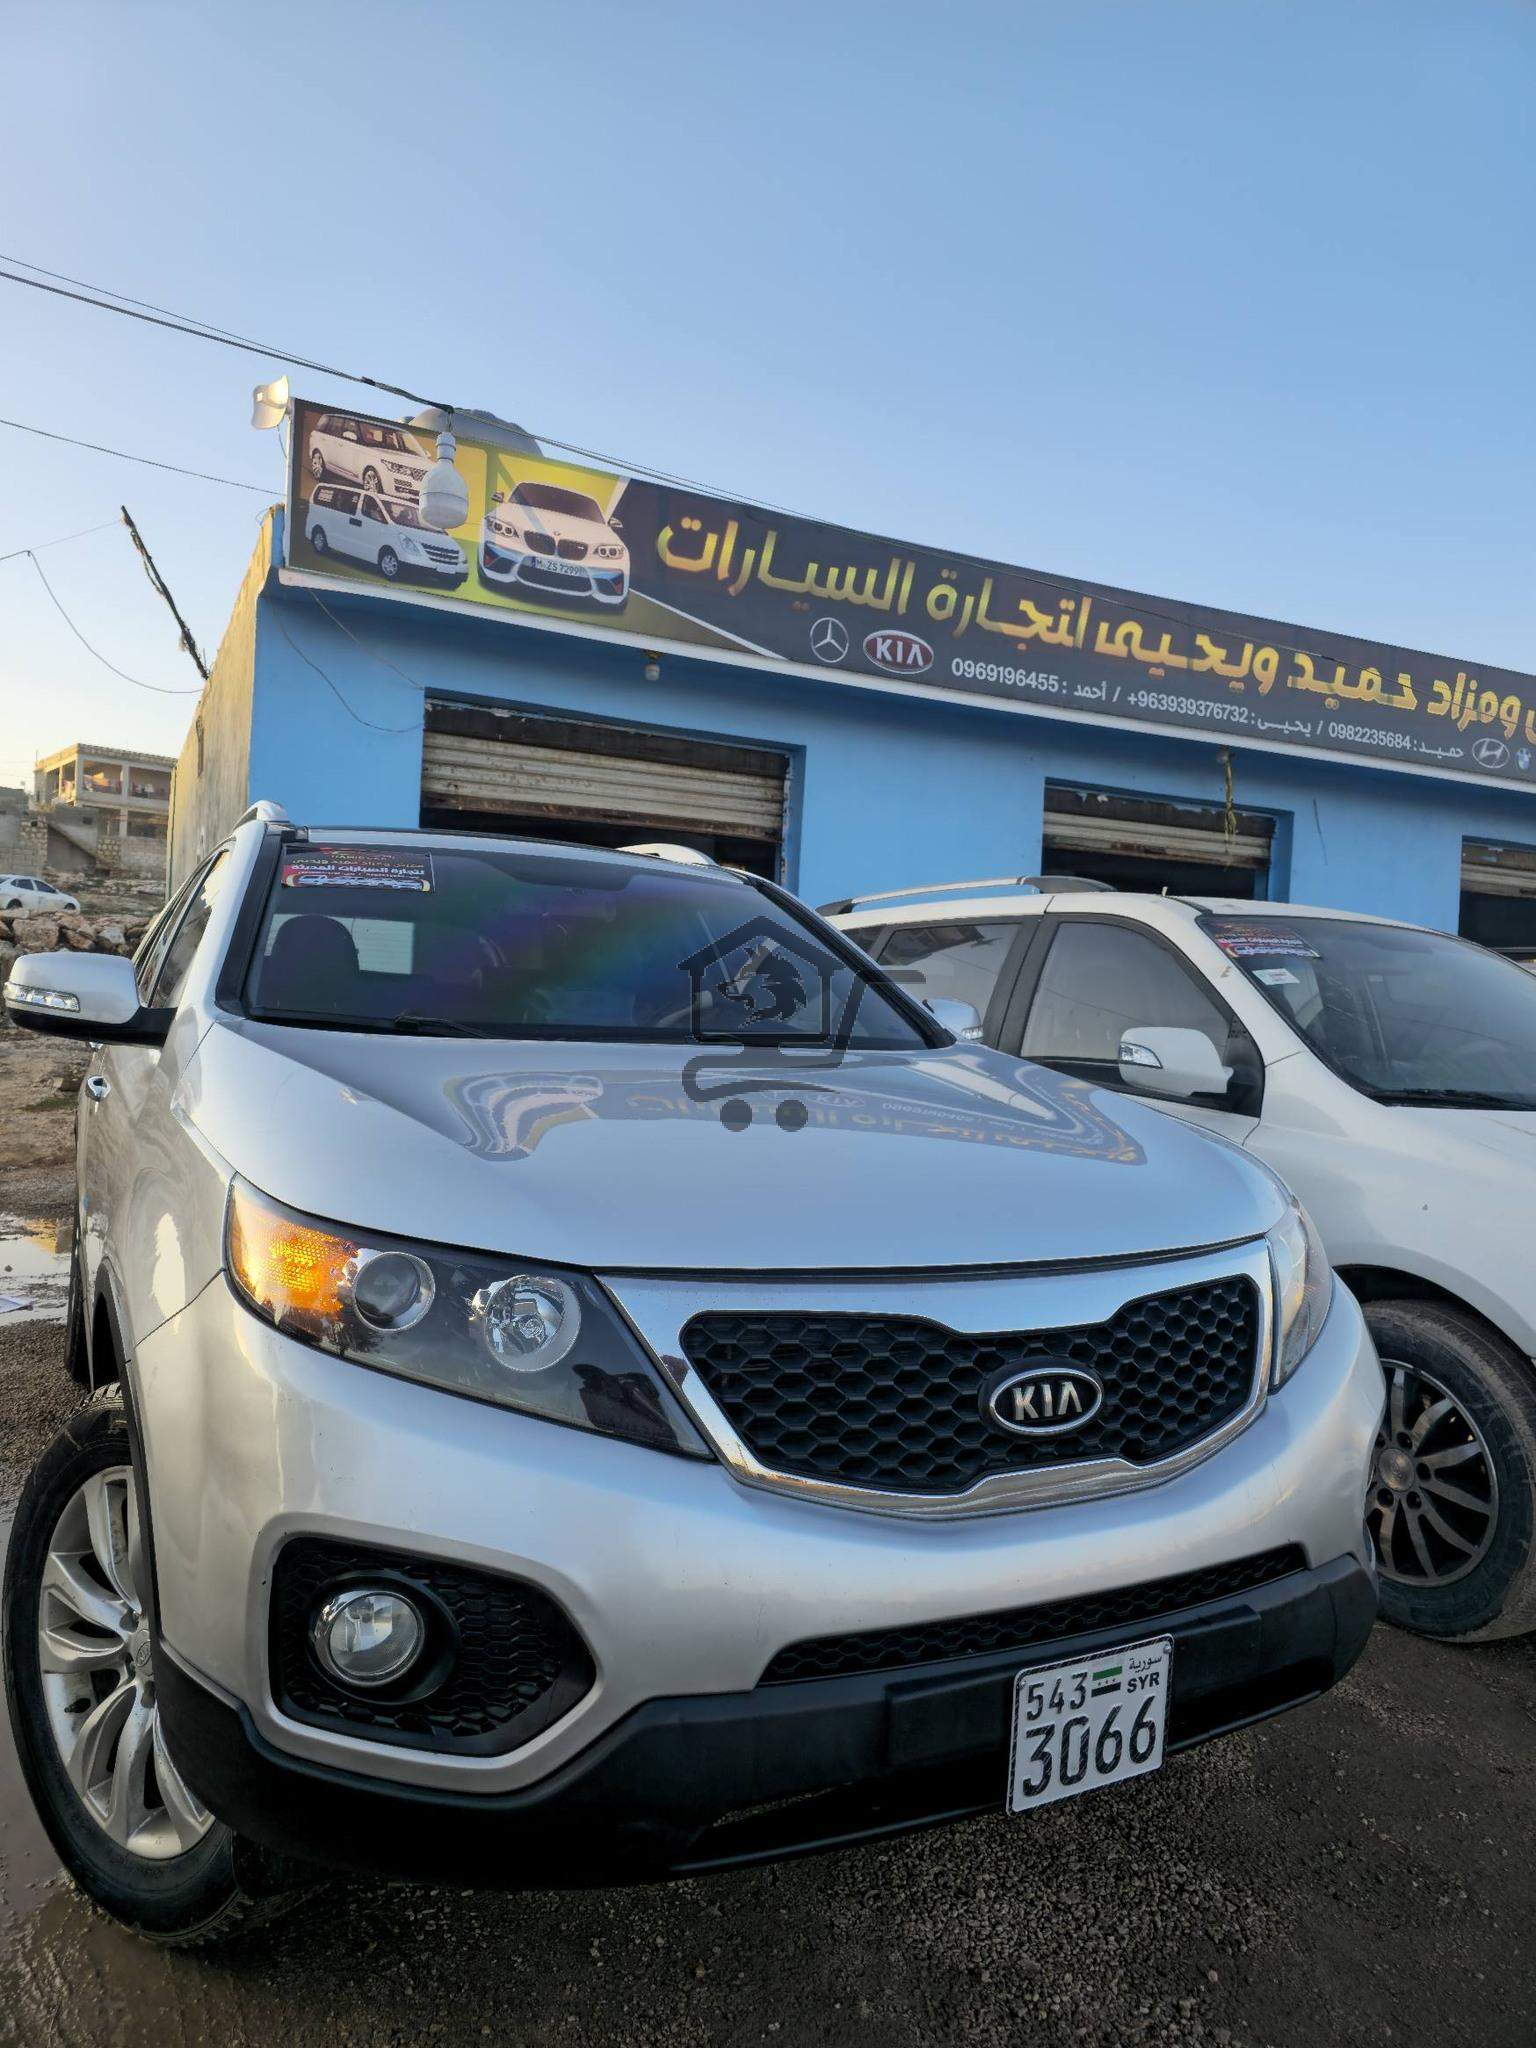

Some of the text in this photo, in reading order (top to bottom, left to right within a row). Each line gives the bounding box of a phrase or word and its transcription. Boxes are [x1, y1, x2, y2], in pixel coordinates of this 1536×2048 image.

[657, 516, 916, 615] السيارات
[875, 638, 924, 667] KIA
[951, 657, 1058, 693] 0969196455
[1287, 652, 1418, 711] حميد
[1328, 721, 1412, 750] 0982235684
[1012, 1381, 1082, 1421] KIA
[1026, 1671, 1160, 1721] 543 SYR
[1022, 1695, 1157, 1797] 3066
